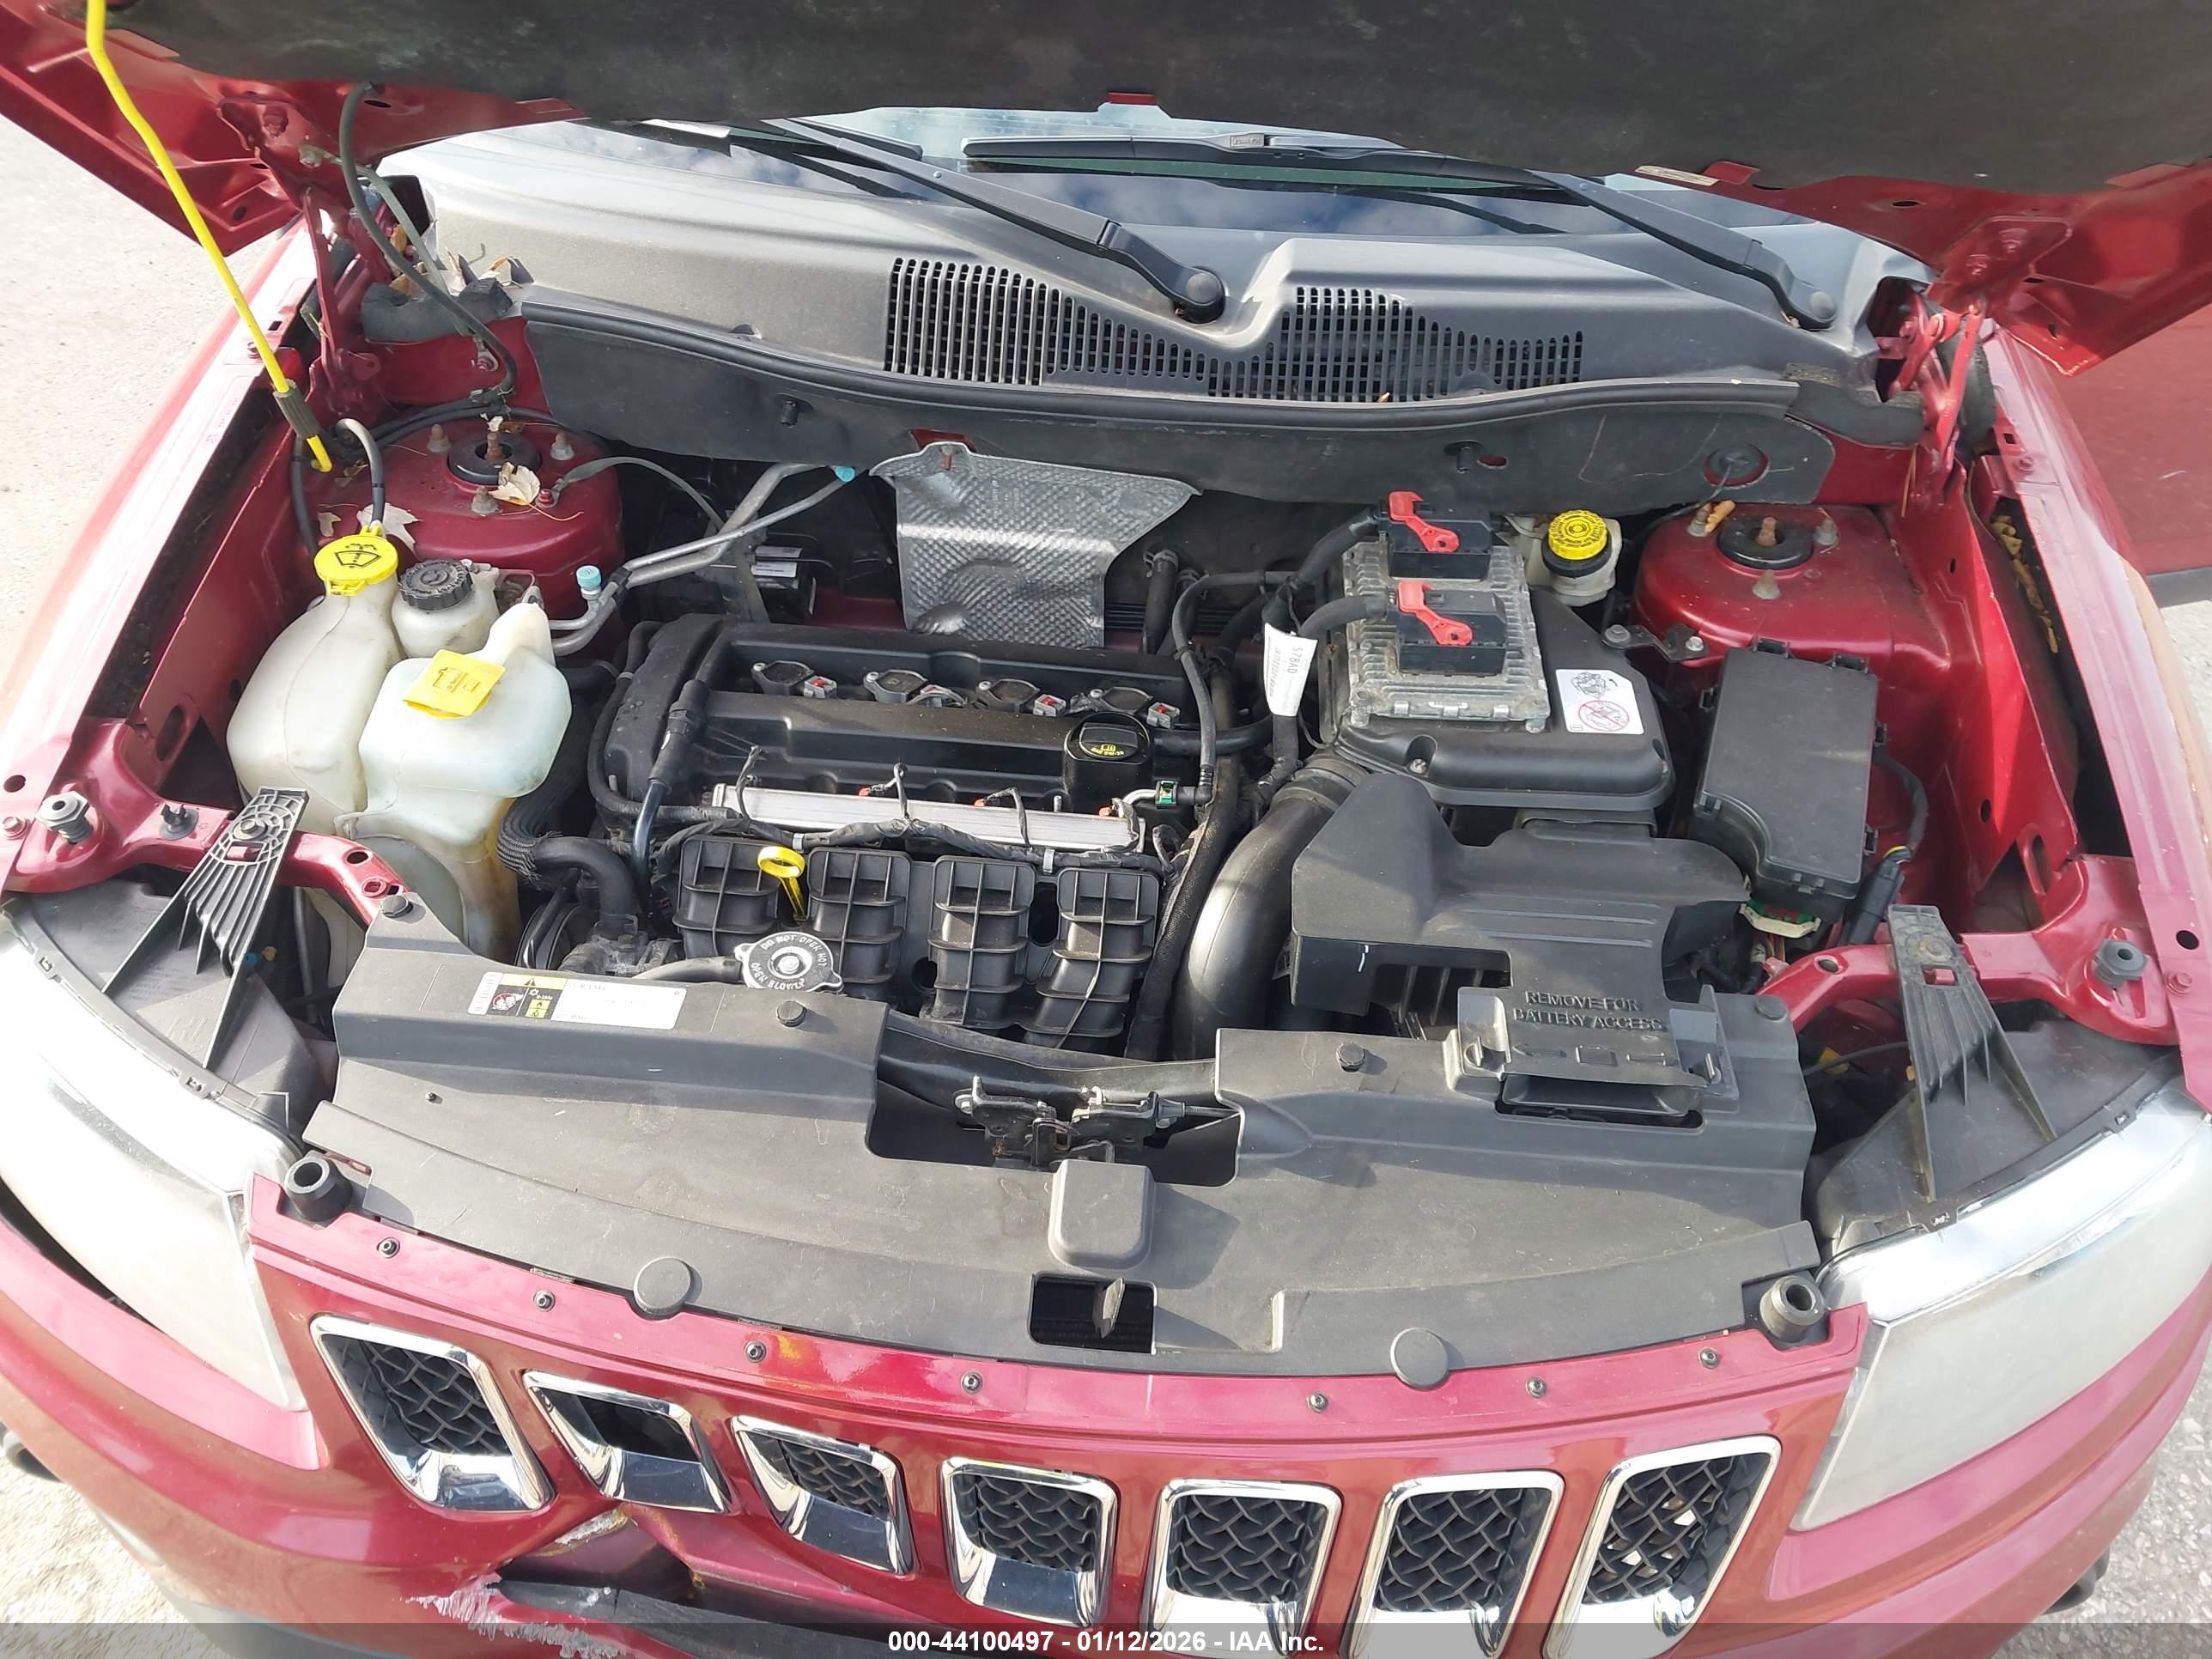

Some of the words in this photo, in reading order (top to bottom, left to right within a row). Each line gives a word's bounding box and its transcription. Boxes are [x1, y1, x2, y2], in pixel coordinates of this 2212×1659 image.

[775, 934, 797, 944] NOT
[1524, 991, 1603, 1010] REMOVE
[1603, 996, 1641, 1012] FOR
[1512, 1008, 1587, 1027] BATTERY
[1592, 1015, 1665, 1031] ACCESS
